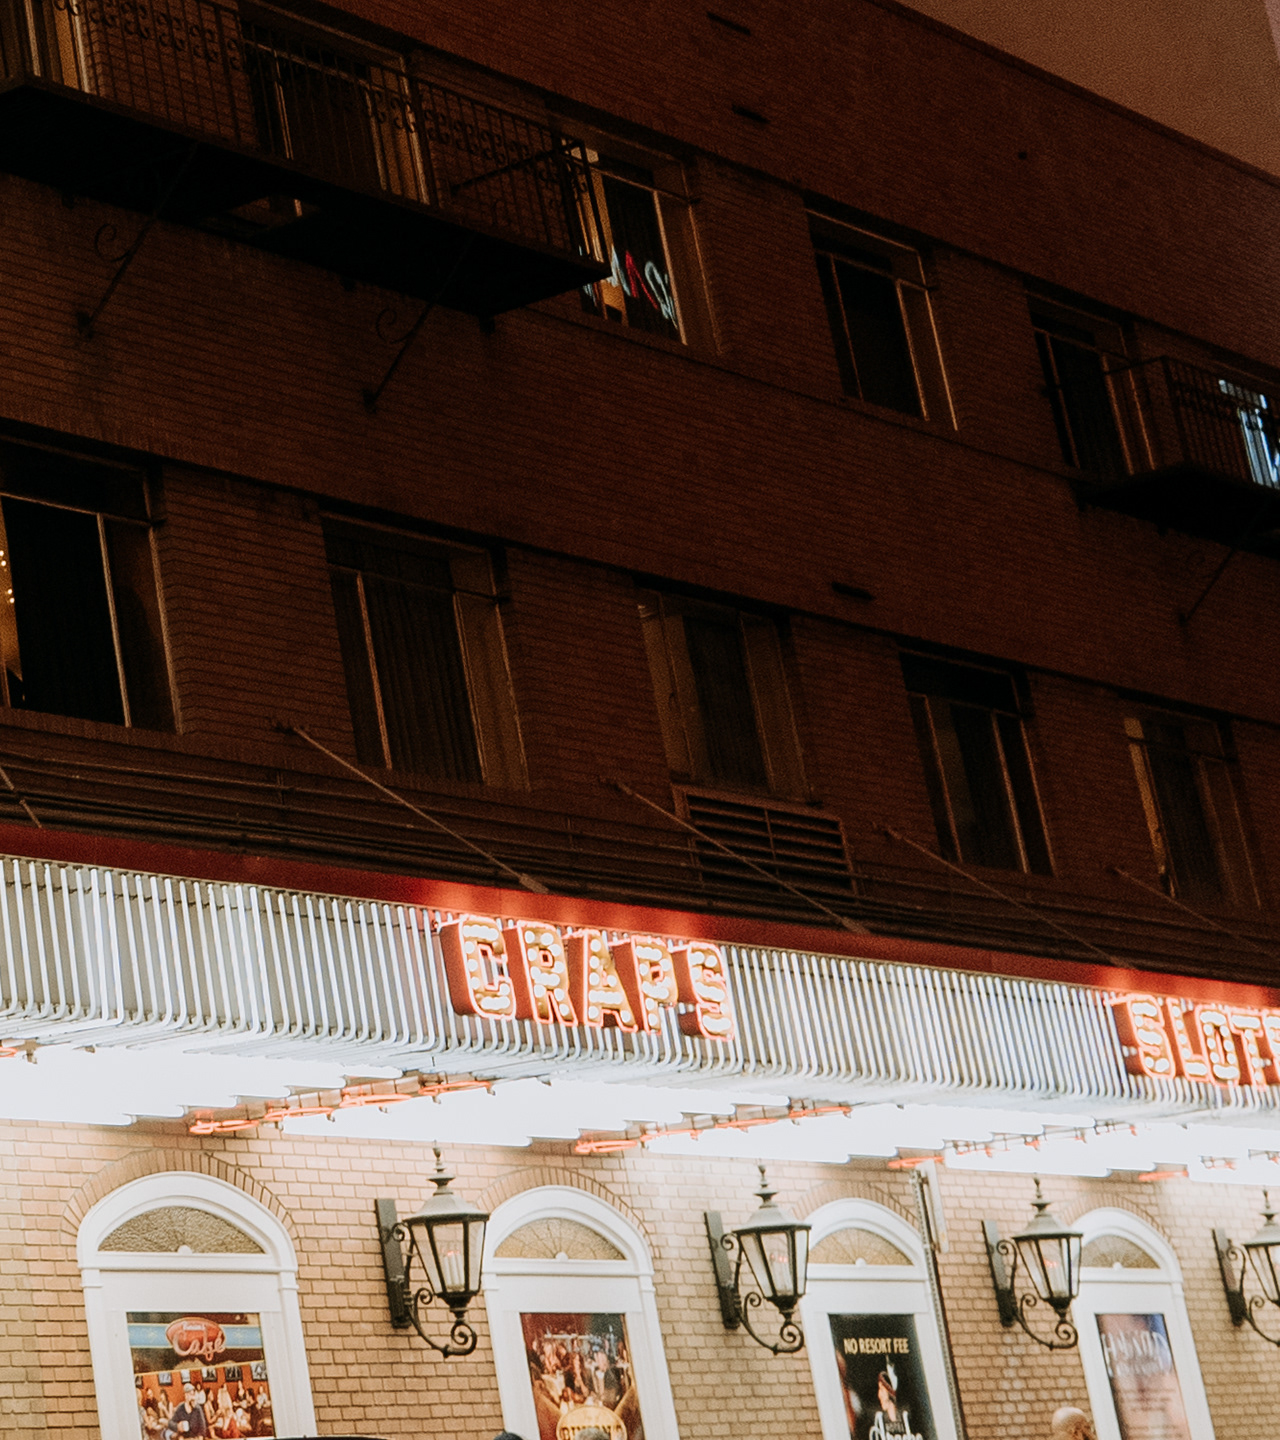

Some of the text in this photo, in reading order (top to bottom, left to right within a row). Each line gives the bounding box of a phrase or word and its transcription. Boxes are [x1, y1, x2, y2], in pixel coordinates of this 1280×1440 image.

[444, 914, 735, 1042] CRAPS
[843, 1337, 910, 1354] NO RESORT FEE
